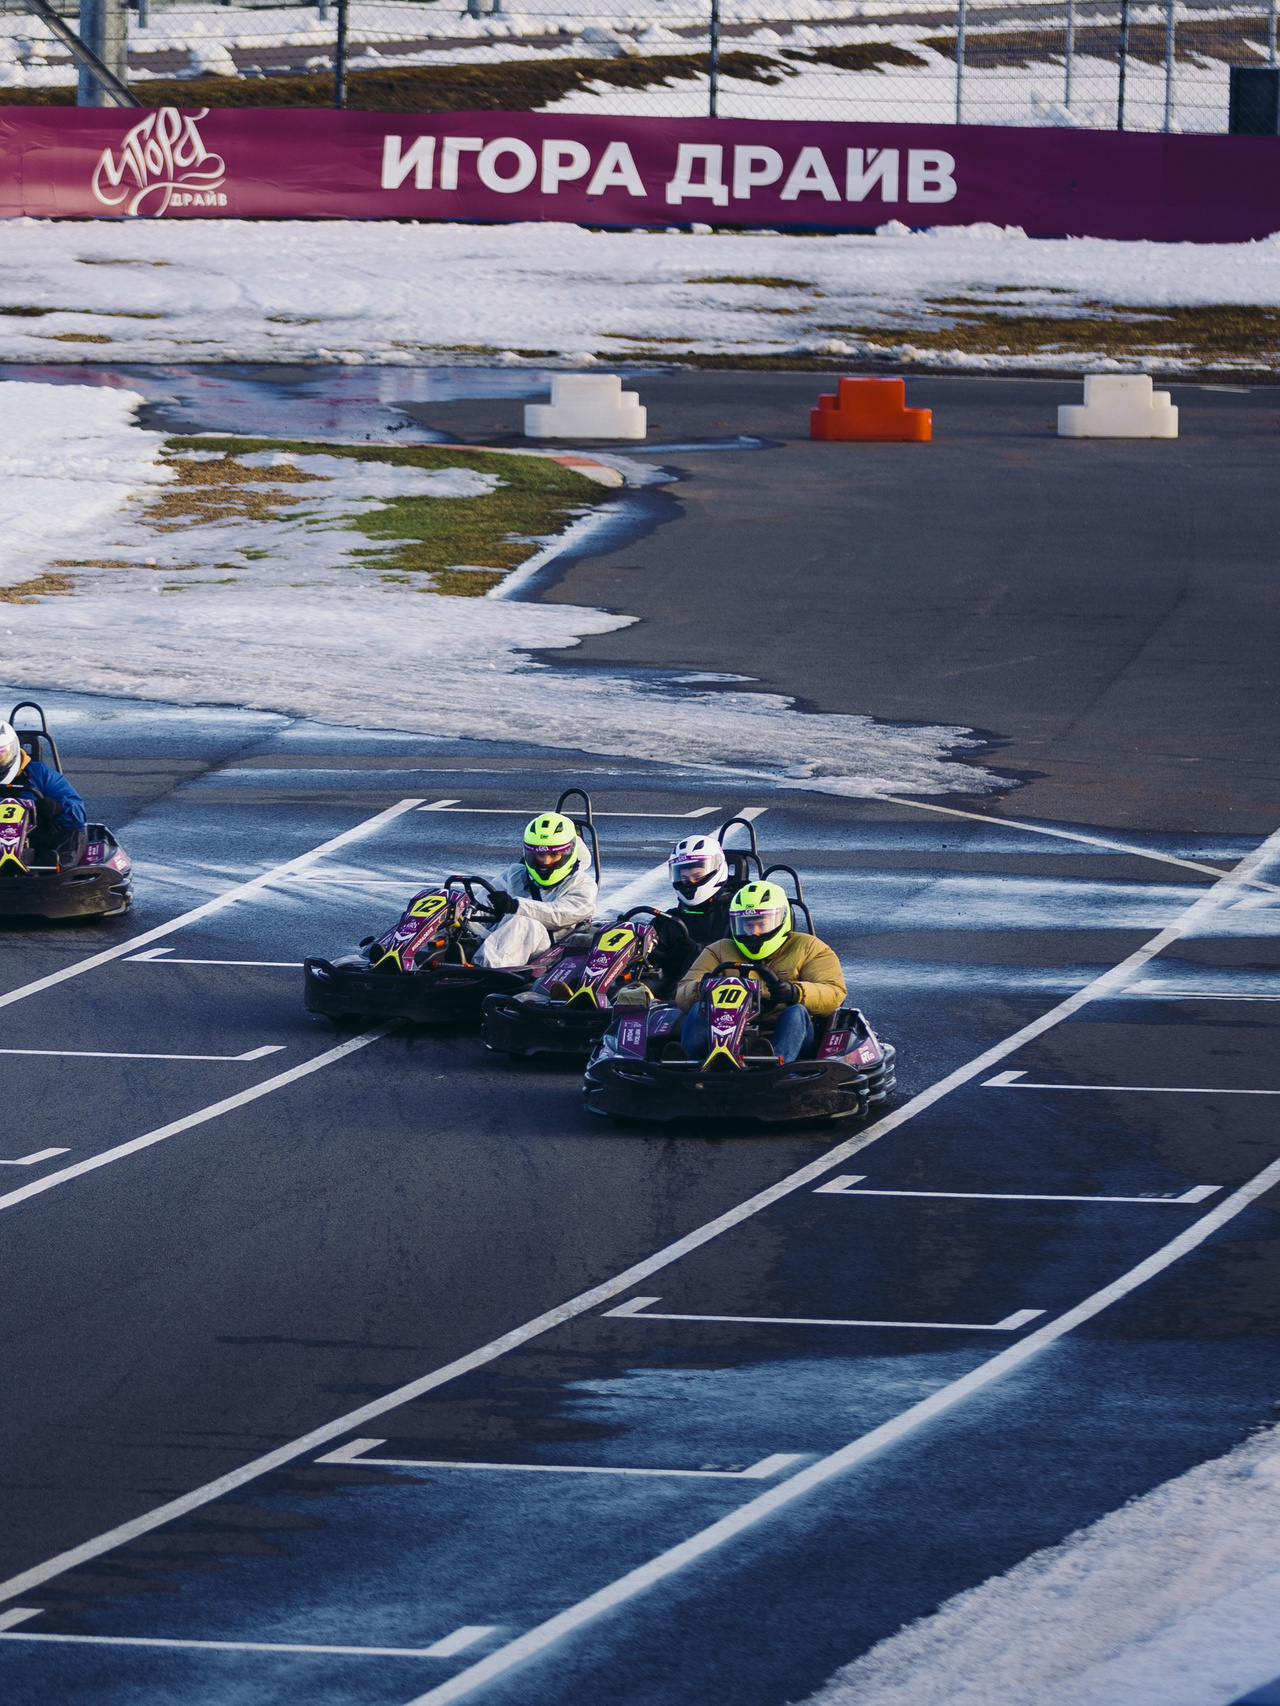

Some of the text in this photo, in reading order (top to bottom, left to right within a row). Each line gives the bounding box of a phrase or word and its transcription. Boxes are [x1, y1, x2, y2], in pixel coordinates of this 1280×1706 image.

[381, 135, 958, 206] ИГОРА ДРАЙВ
[170, 190, 228, 207] ДРАЙВ
[2, 806, 17, 819] 3
[413, 897, 442, 914] 12
[606, 932, 626, 947] 4
[717, 988, 742, 1004] 10
